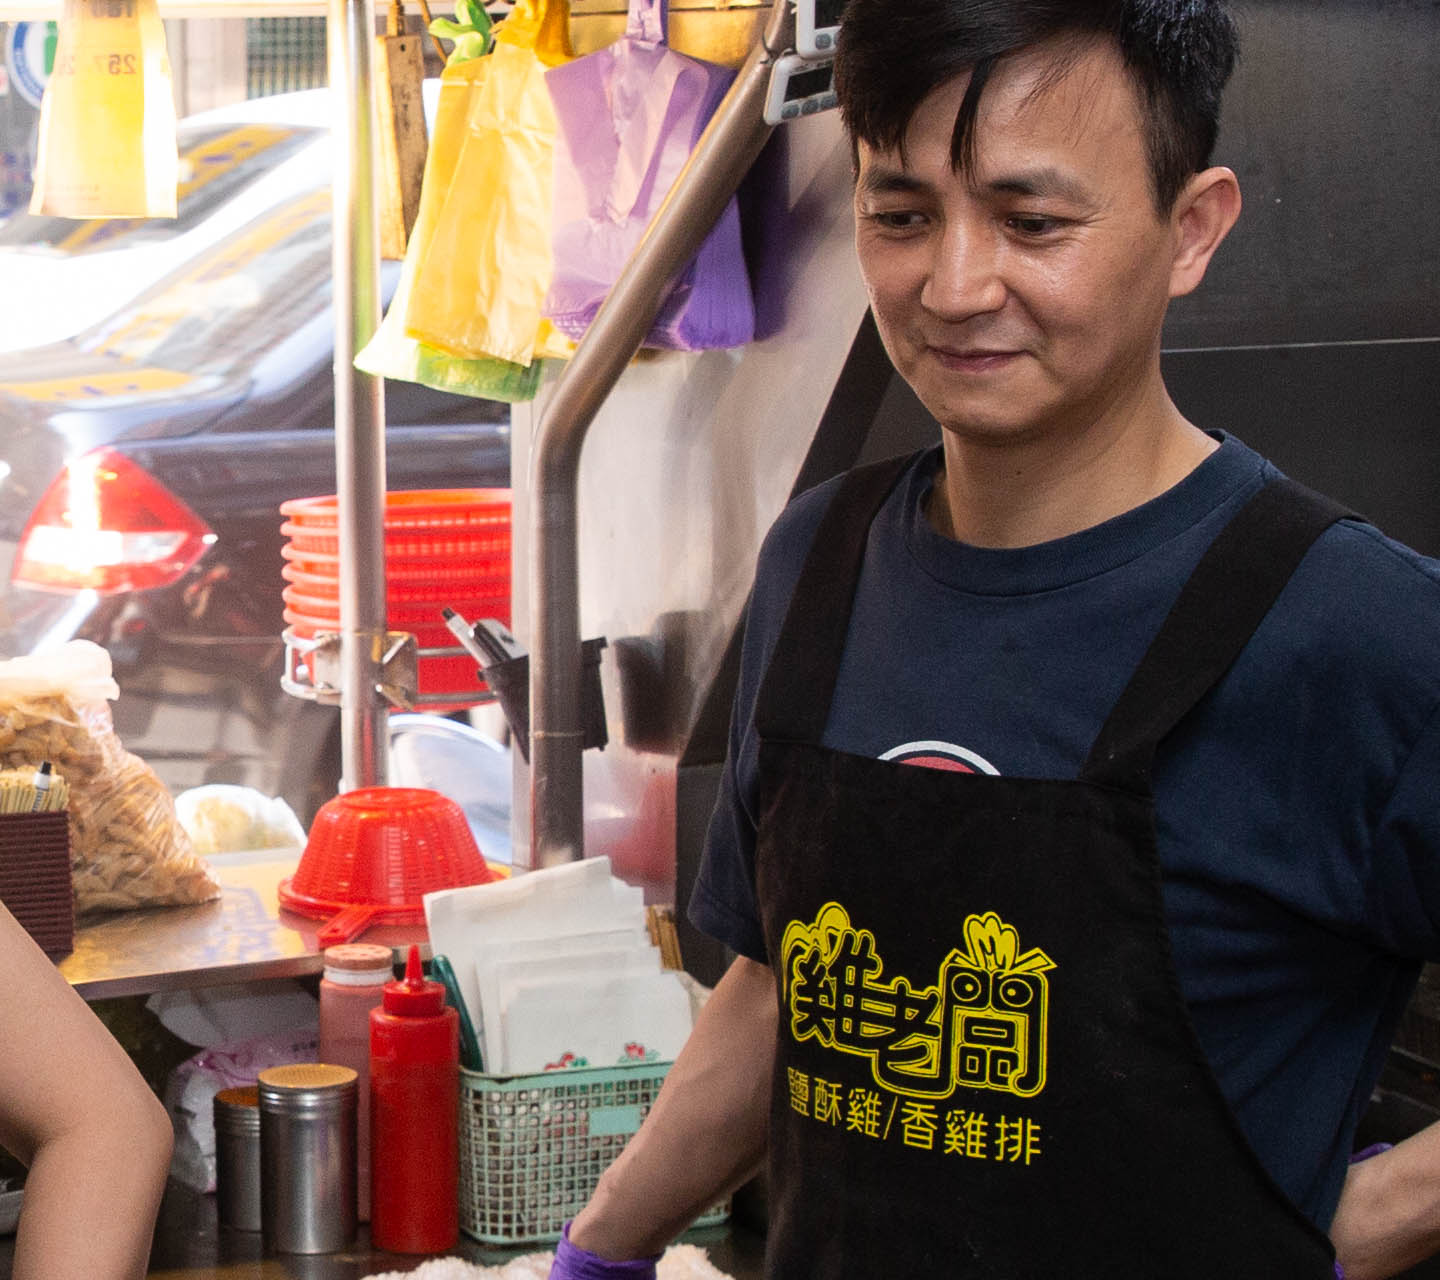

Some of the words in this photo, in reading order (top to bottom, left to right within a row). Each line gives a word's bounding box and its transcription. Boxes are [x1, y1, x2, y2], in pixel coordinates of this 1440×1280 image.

[781, 902, 1058, 1100] 雞老闆
[787, 1066, 1042, 1166] 鹽酥雞/香雞排
